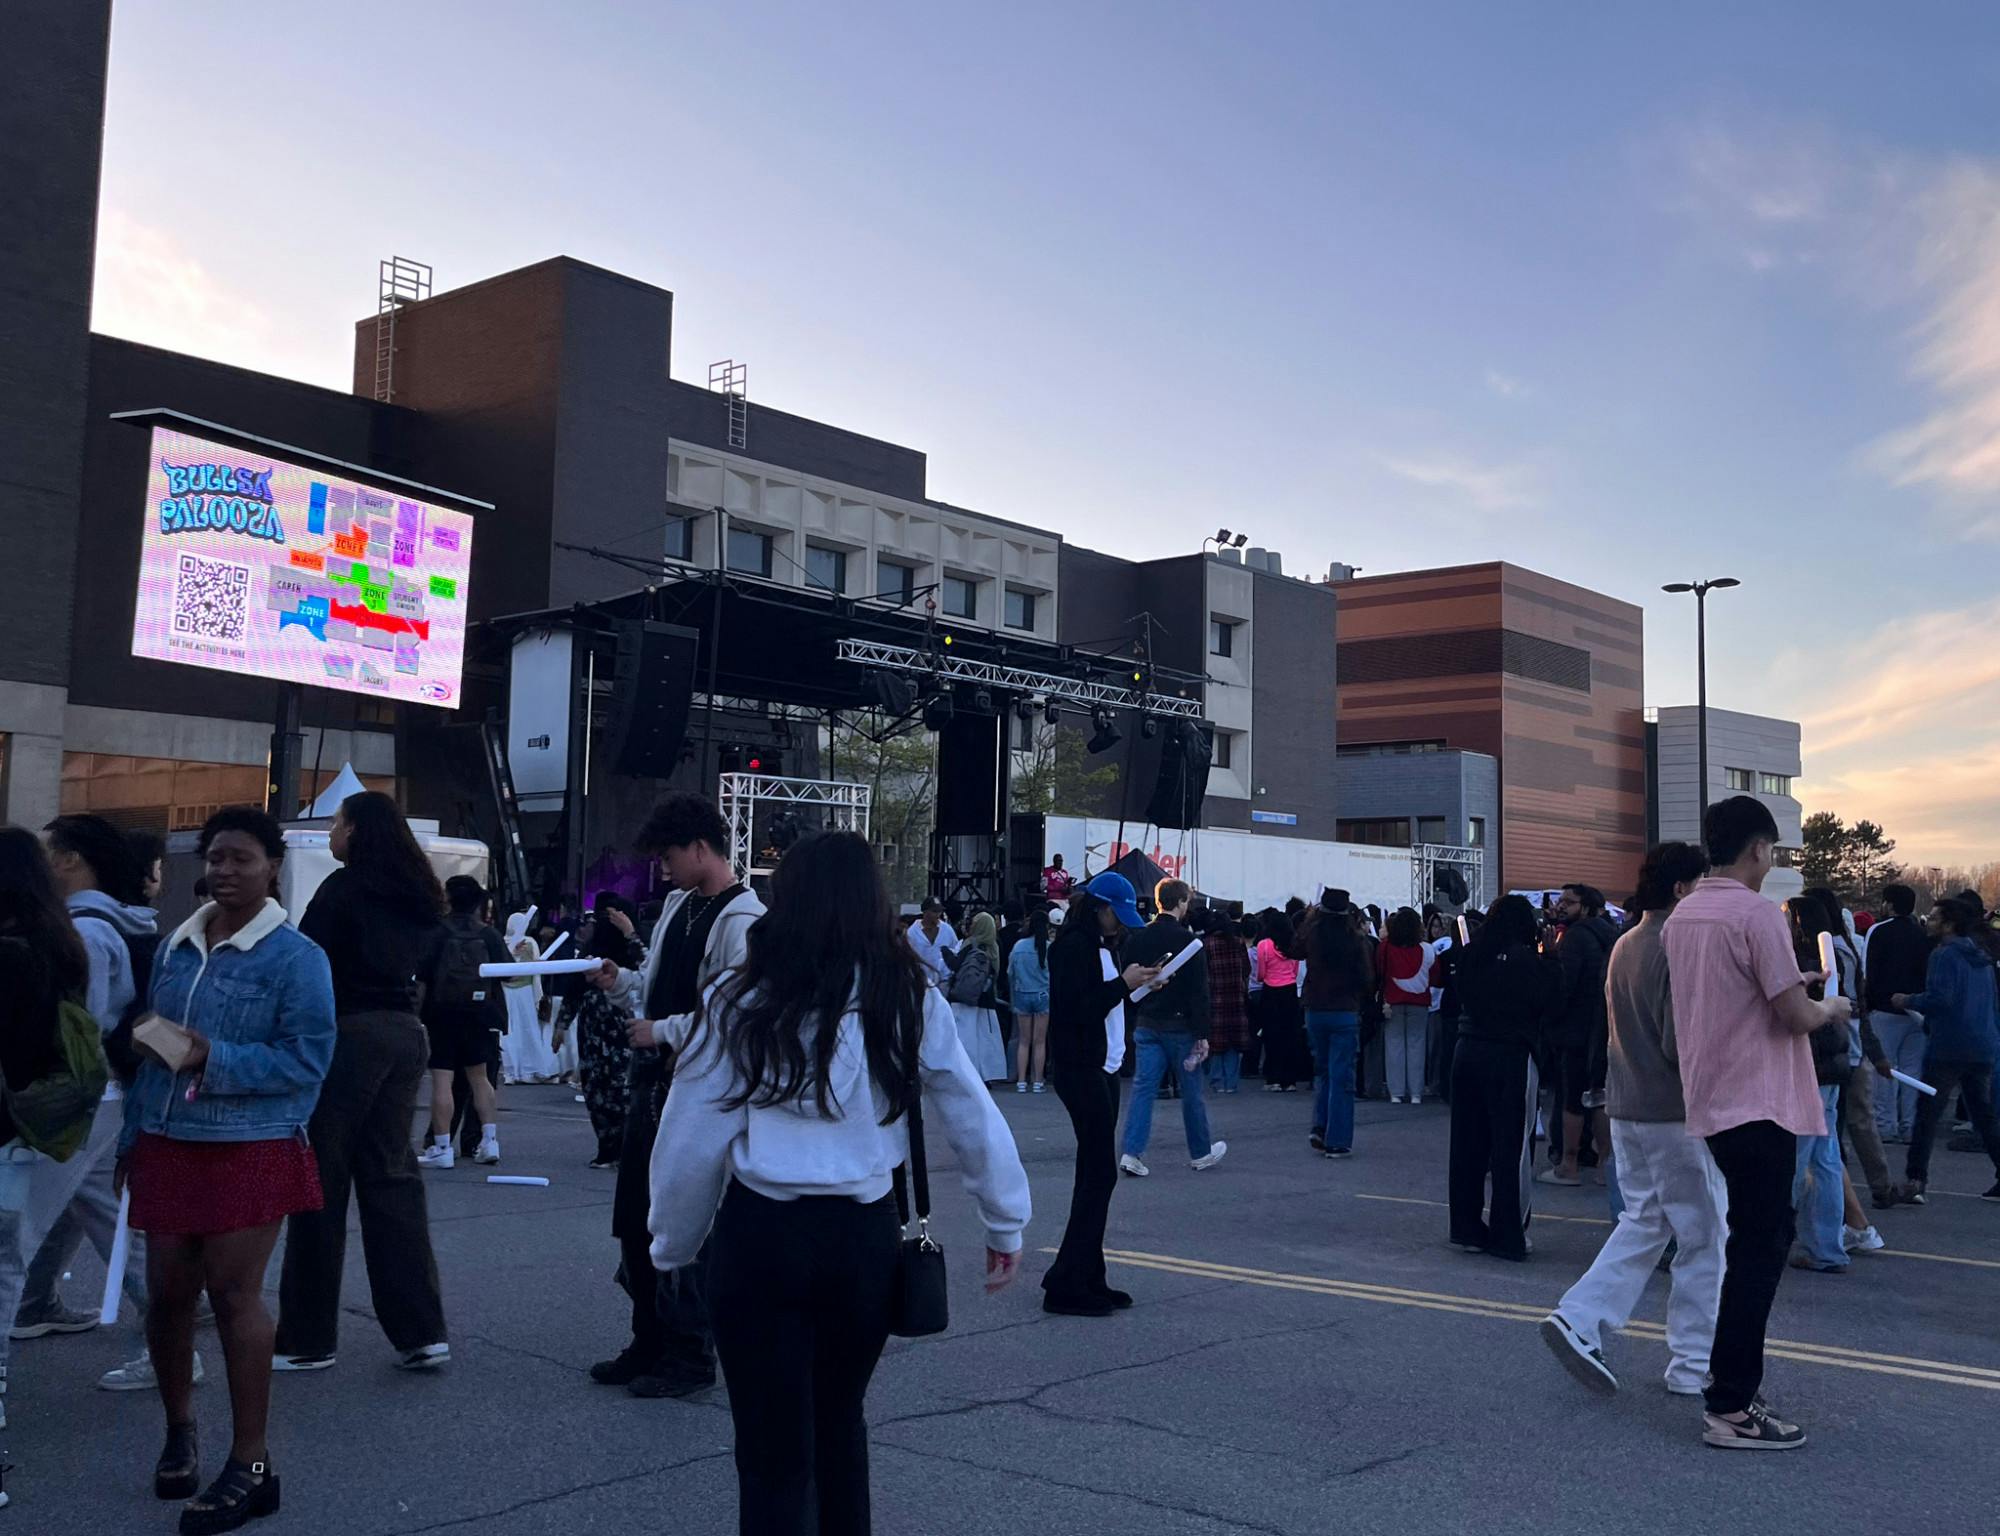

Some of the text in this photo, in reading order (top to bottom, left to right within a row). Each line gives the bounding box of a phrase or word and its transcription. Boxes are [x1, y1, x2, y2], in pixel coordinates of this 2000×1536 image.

[159, 496, 285, 544] PALOOZA
[394, 540, 415, 554] ZONE
[277, 580, 302, 593] CAPEN
[364, 588, 385, 600] ZONE
[300, 605, 325, 618] ZONE
[169, 639, 180, 648] SEE
[182, 640, 193, 649] THE
[1108, 841, 1187, 879] Rder
